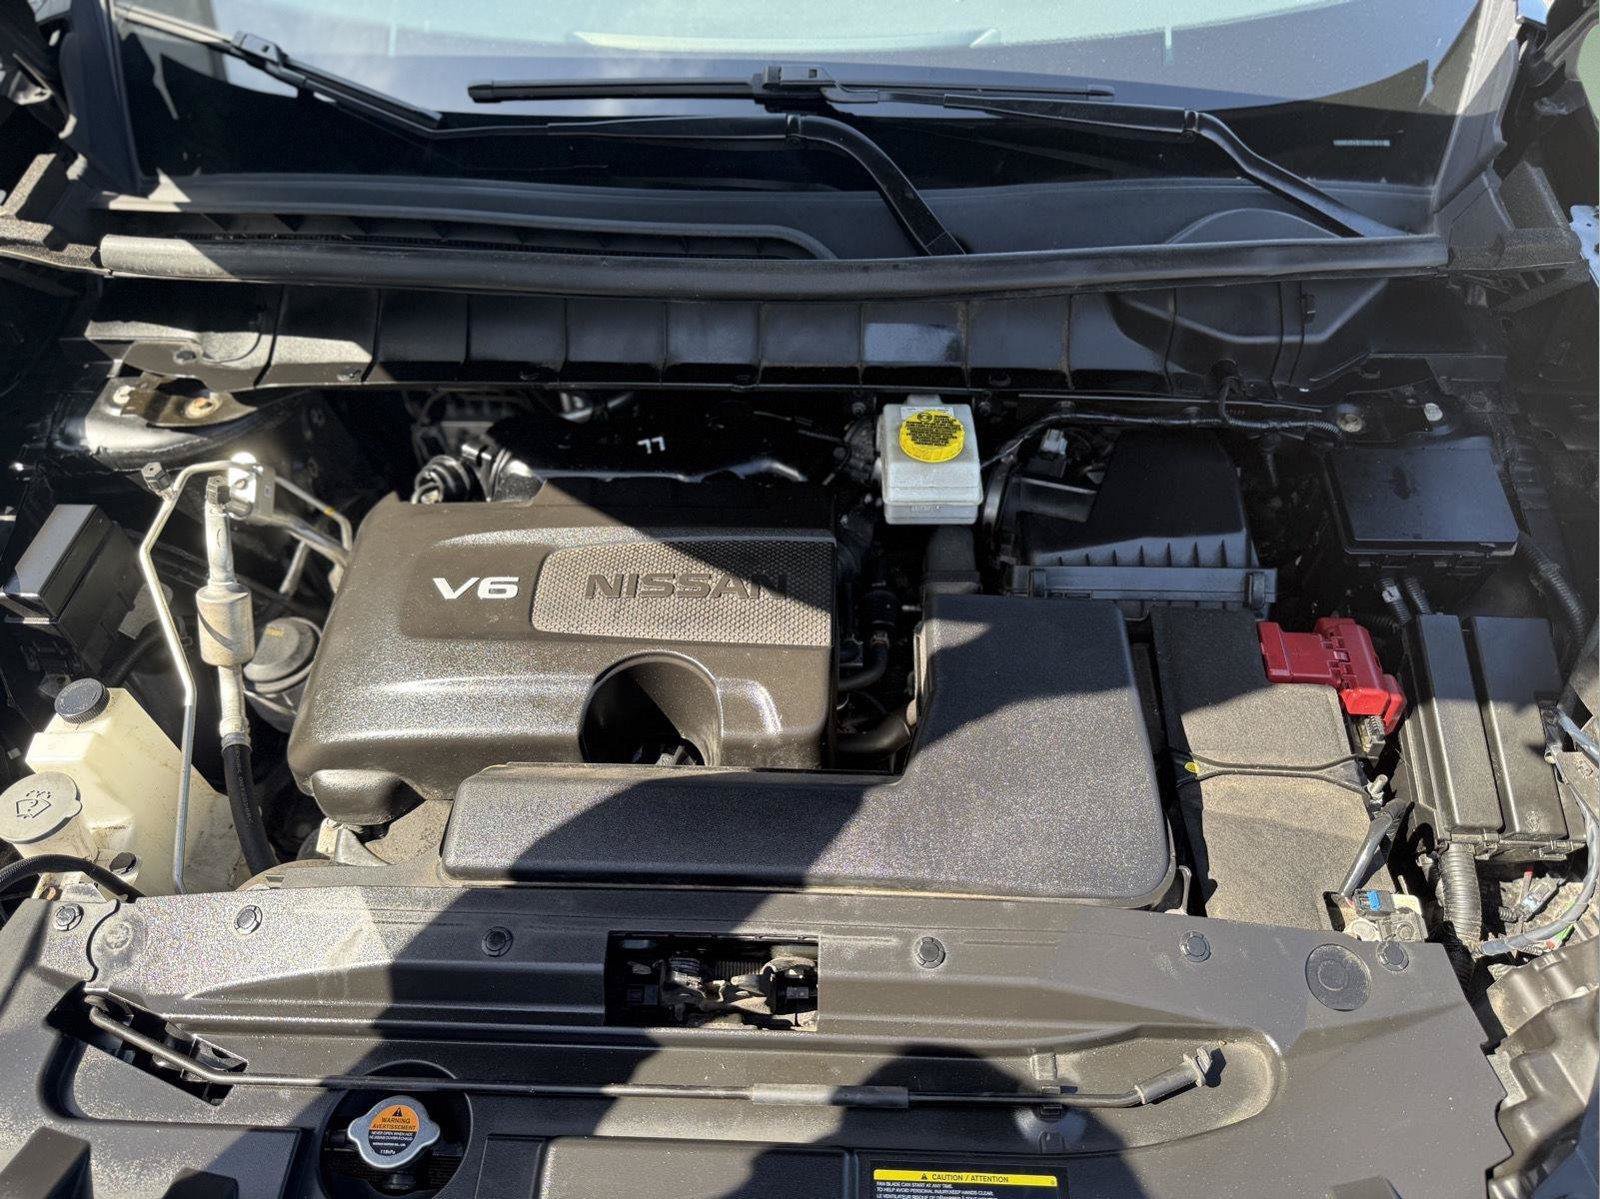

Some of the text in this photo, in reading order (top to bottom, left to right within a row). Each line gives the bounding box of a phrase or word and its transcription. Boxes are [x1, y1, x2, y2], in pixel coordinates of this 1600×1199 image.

[432, 576, 520, 600] V6
[585, 573, 787, 600] NISSAN
[932, 1173, 963, 1181] CAUTION
